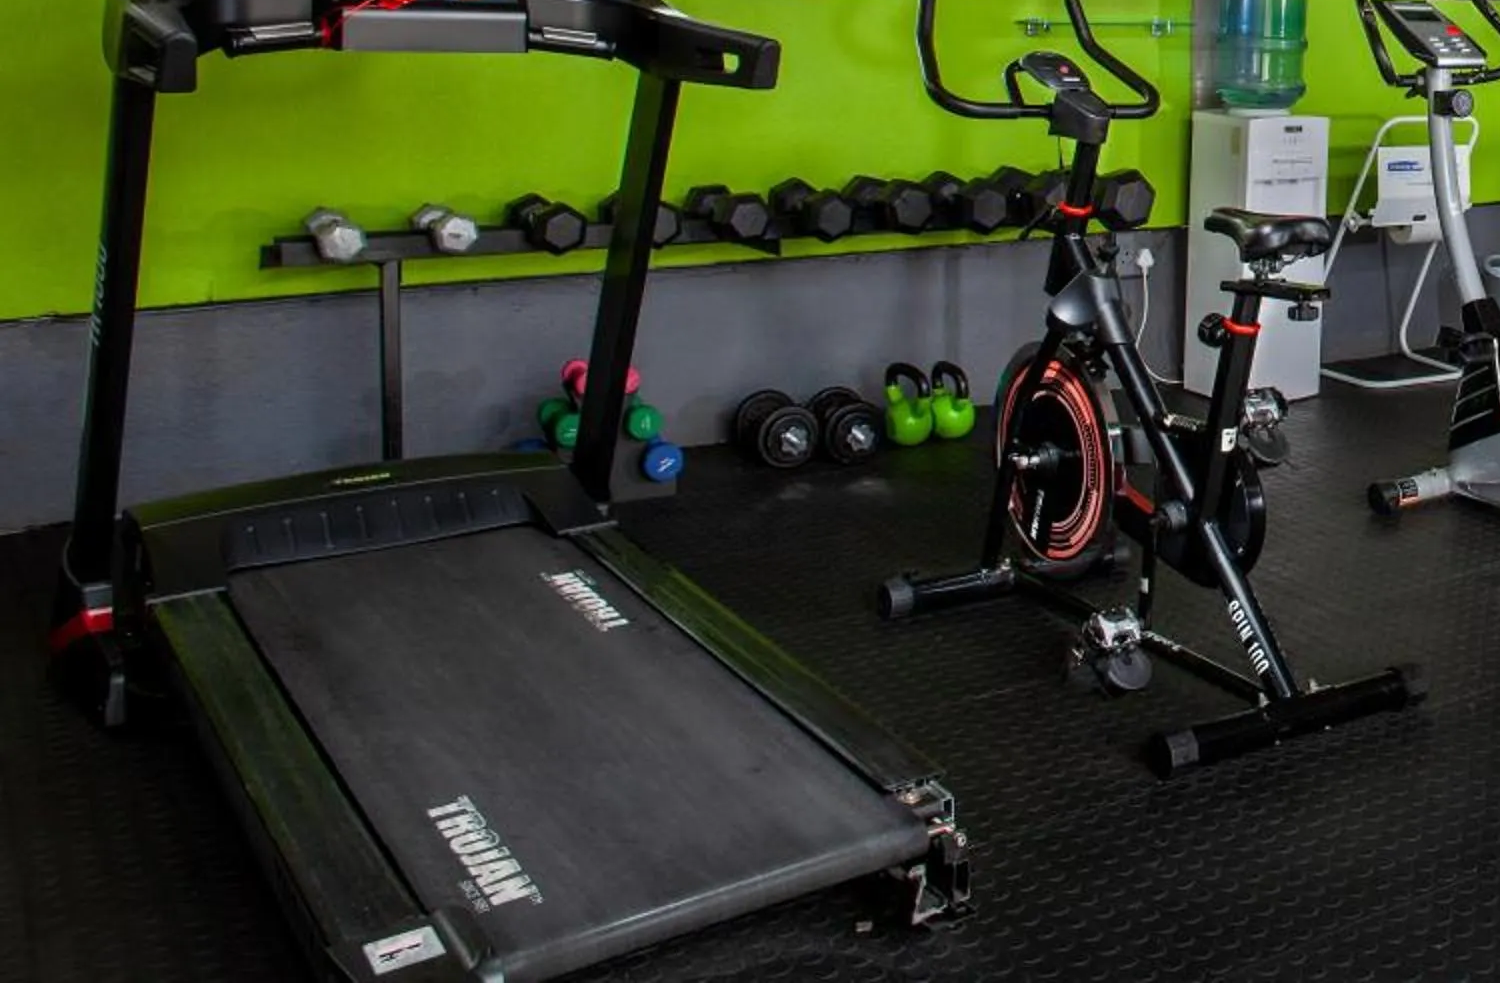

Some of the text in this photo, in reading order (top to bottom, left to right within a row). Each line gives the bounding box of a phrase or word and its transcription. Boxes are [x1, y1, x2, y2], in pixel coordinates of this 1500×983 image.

[1228, 599, 1270, 676] SPIN 100
[426, 794, 540, 907] TROJAN
